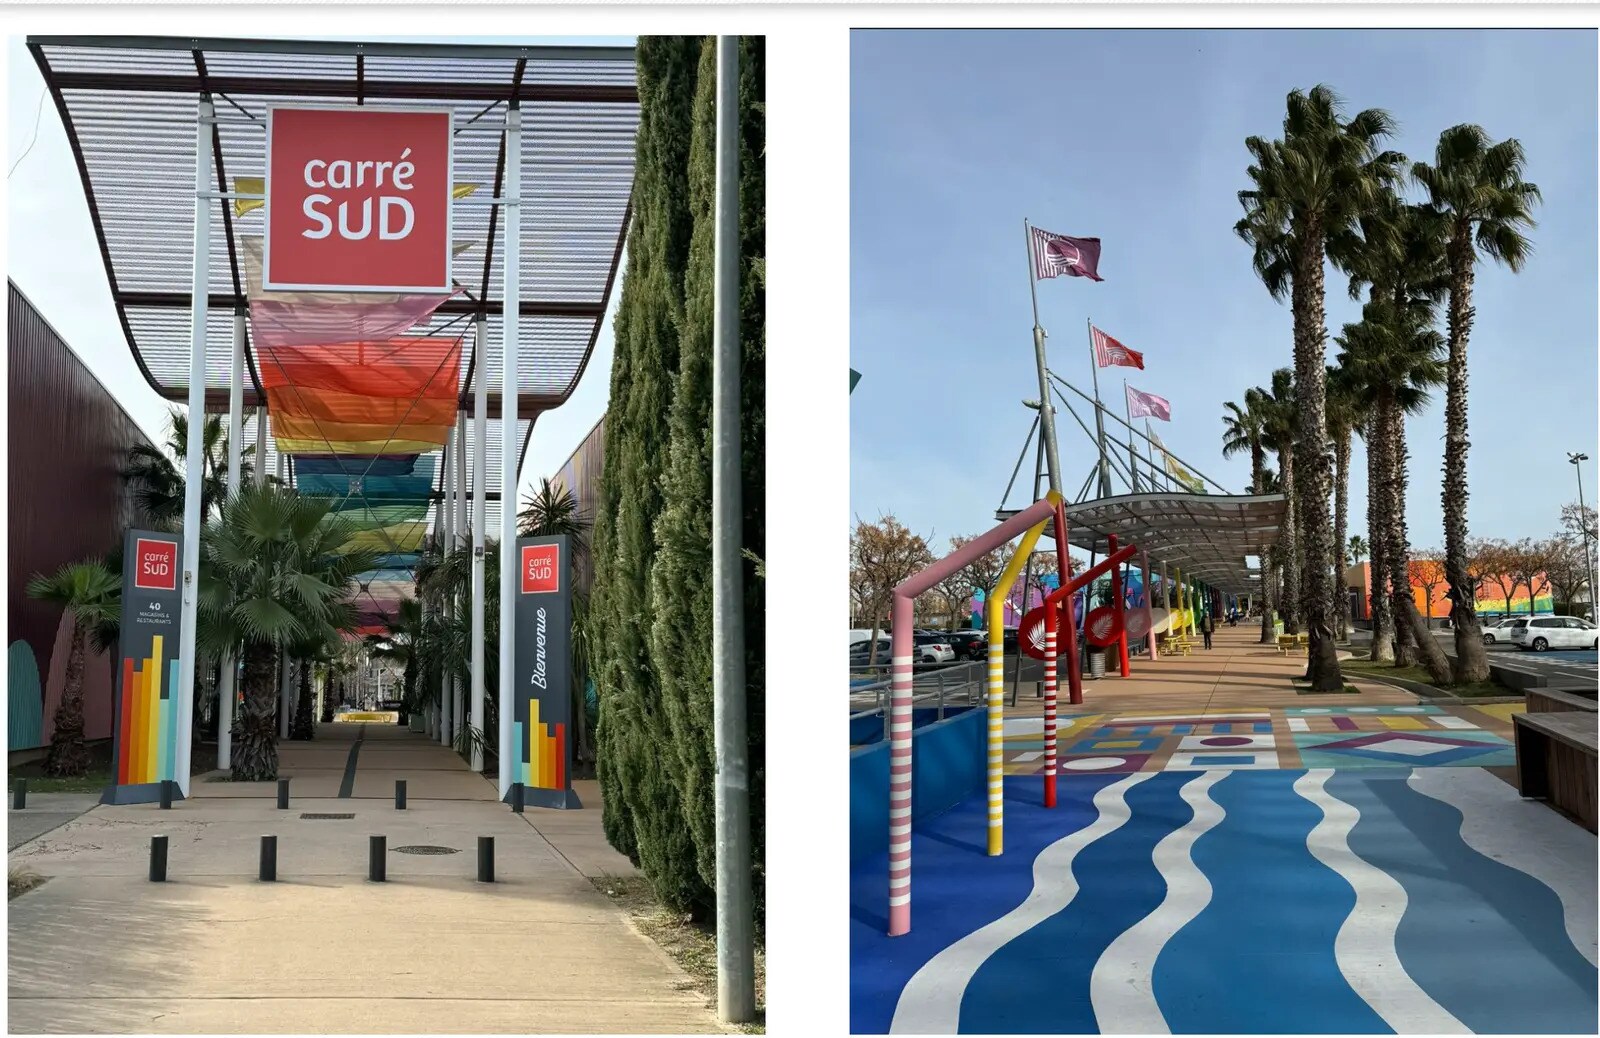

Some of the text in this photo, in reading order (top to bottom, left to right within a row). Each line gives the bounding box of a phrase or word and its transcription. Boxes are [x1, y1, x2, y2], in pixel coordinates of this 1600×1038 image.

[304, 147, 415, 190] carré
[302, 194, 415, 240] SUD
[144, 552, 169, 562] carré
[528, 555, 552, 567] carré
[143, 562, 169, 575] SUD
[528, 567, 552, 580] SUD
[149, 602, 161, 610] 40
[531, 607, 547, 690] Bienvenue
